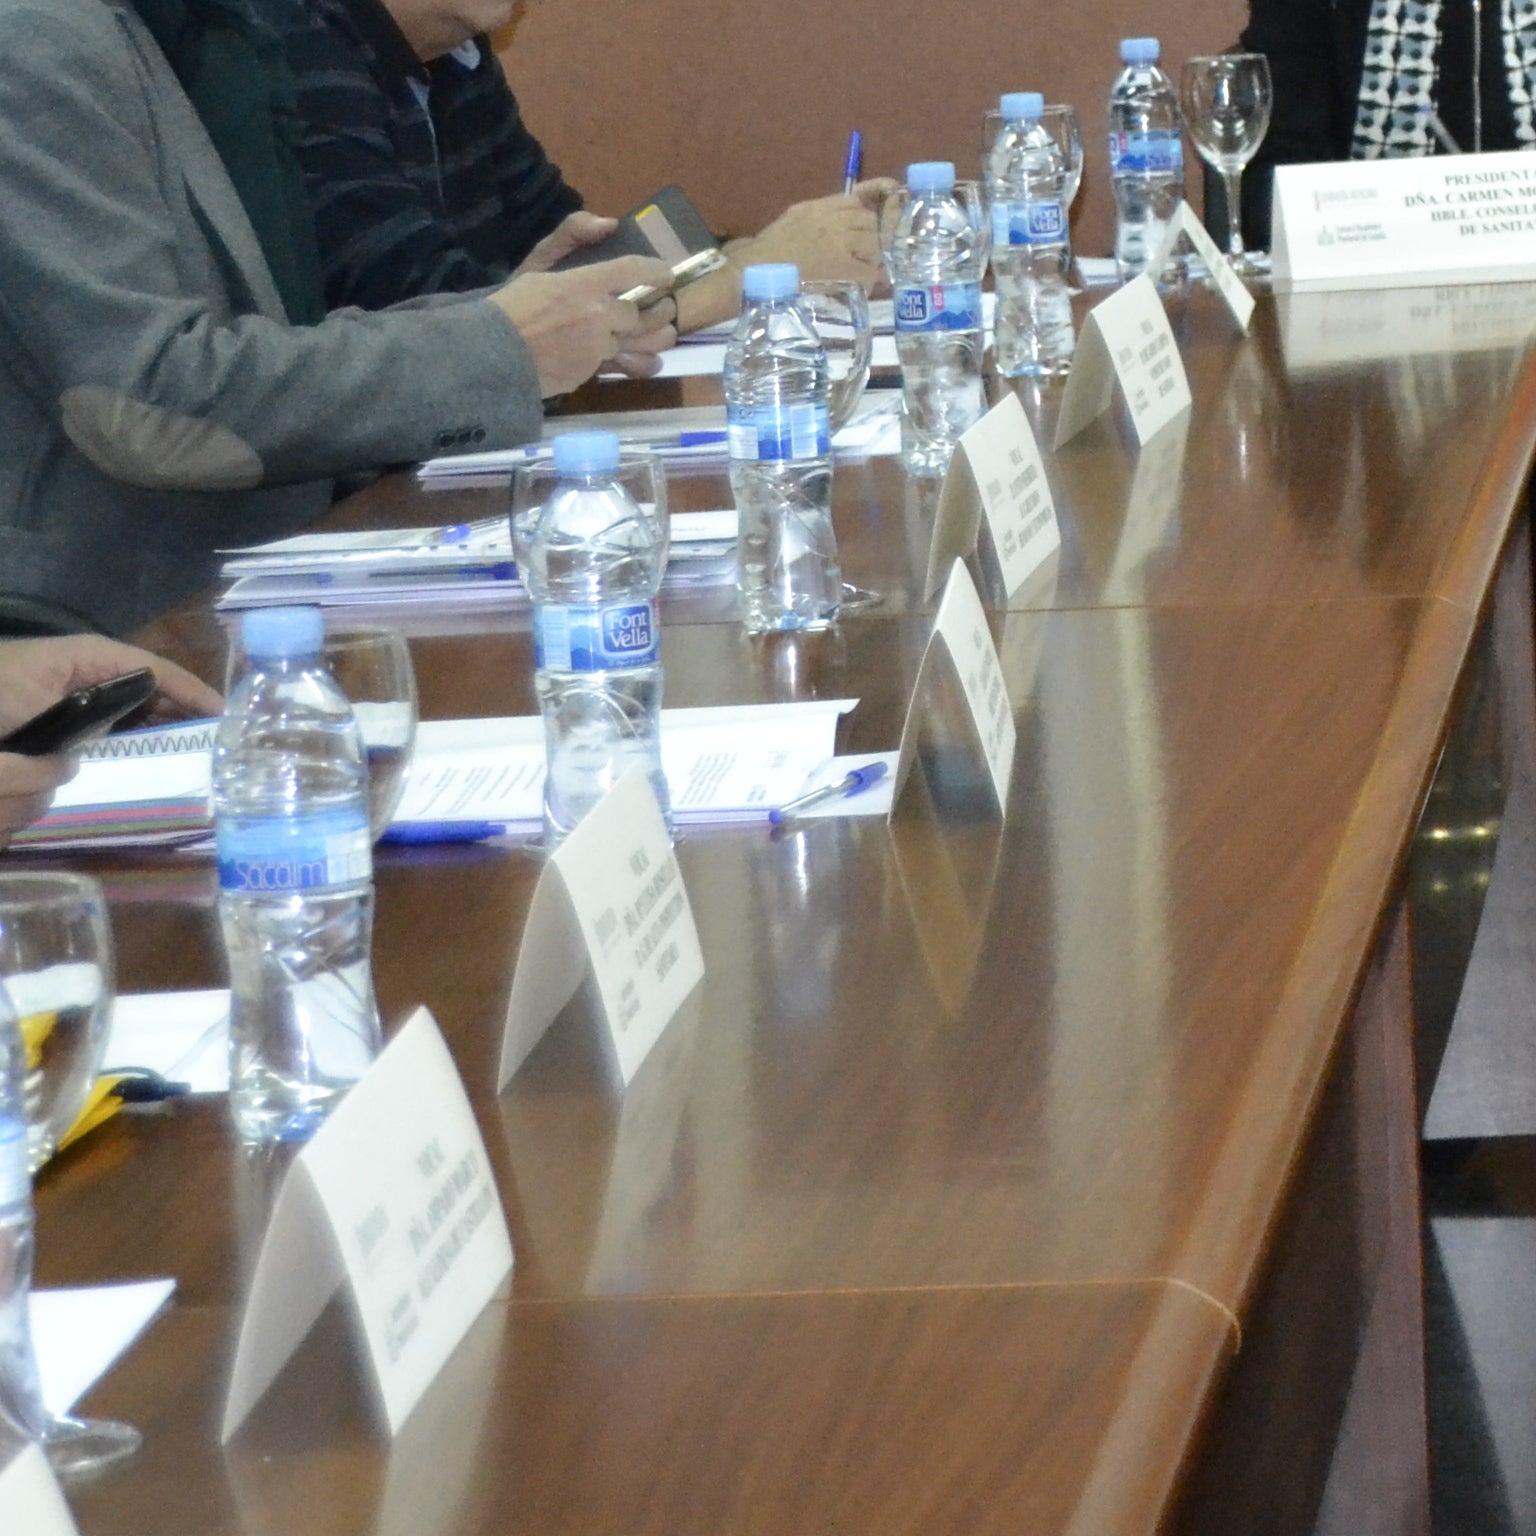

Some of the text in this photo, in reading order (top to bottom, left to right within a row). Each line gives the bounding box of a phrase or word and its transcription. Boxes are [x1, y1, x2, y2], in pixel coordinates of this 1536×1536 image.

[1445, 188, 1513, 204] CARMEN
[1459, 224, 1477, 236] DE
[610, 611, 647, 630] Font
[609, 626, 650, 648] Vella
